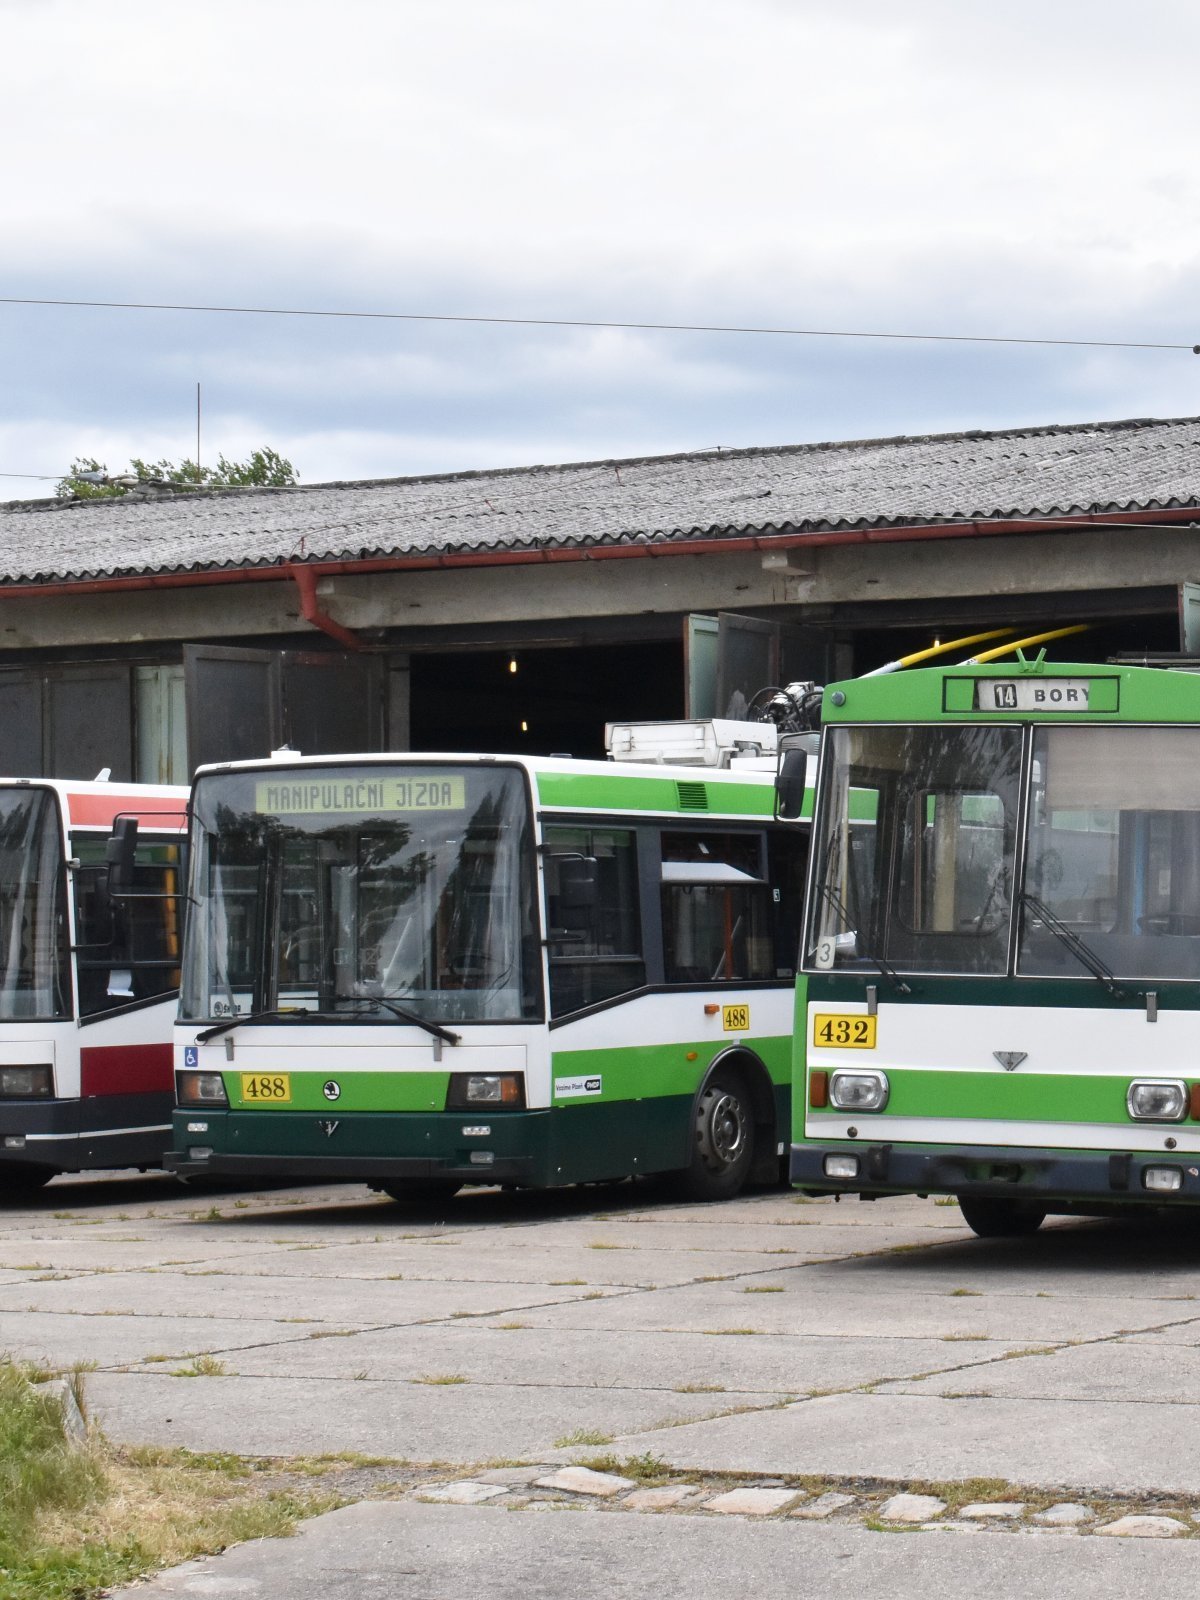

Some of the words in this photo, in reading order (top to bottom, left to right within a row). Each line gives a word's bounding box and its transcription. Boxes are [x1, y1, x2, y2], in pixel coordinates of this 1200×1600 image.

[996, 686, 1015, 707] 14
[267, 778, 384, 811] MANIPULAČNÍ
[396, 778, 452, 807] JÍZDA
[820, 943, 831, 962] 3
[725, 1008, 746, 1027] 488
[819, 1020, 868, 1043] 432
[246, 1077, 286, 1098] 488
